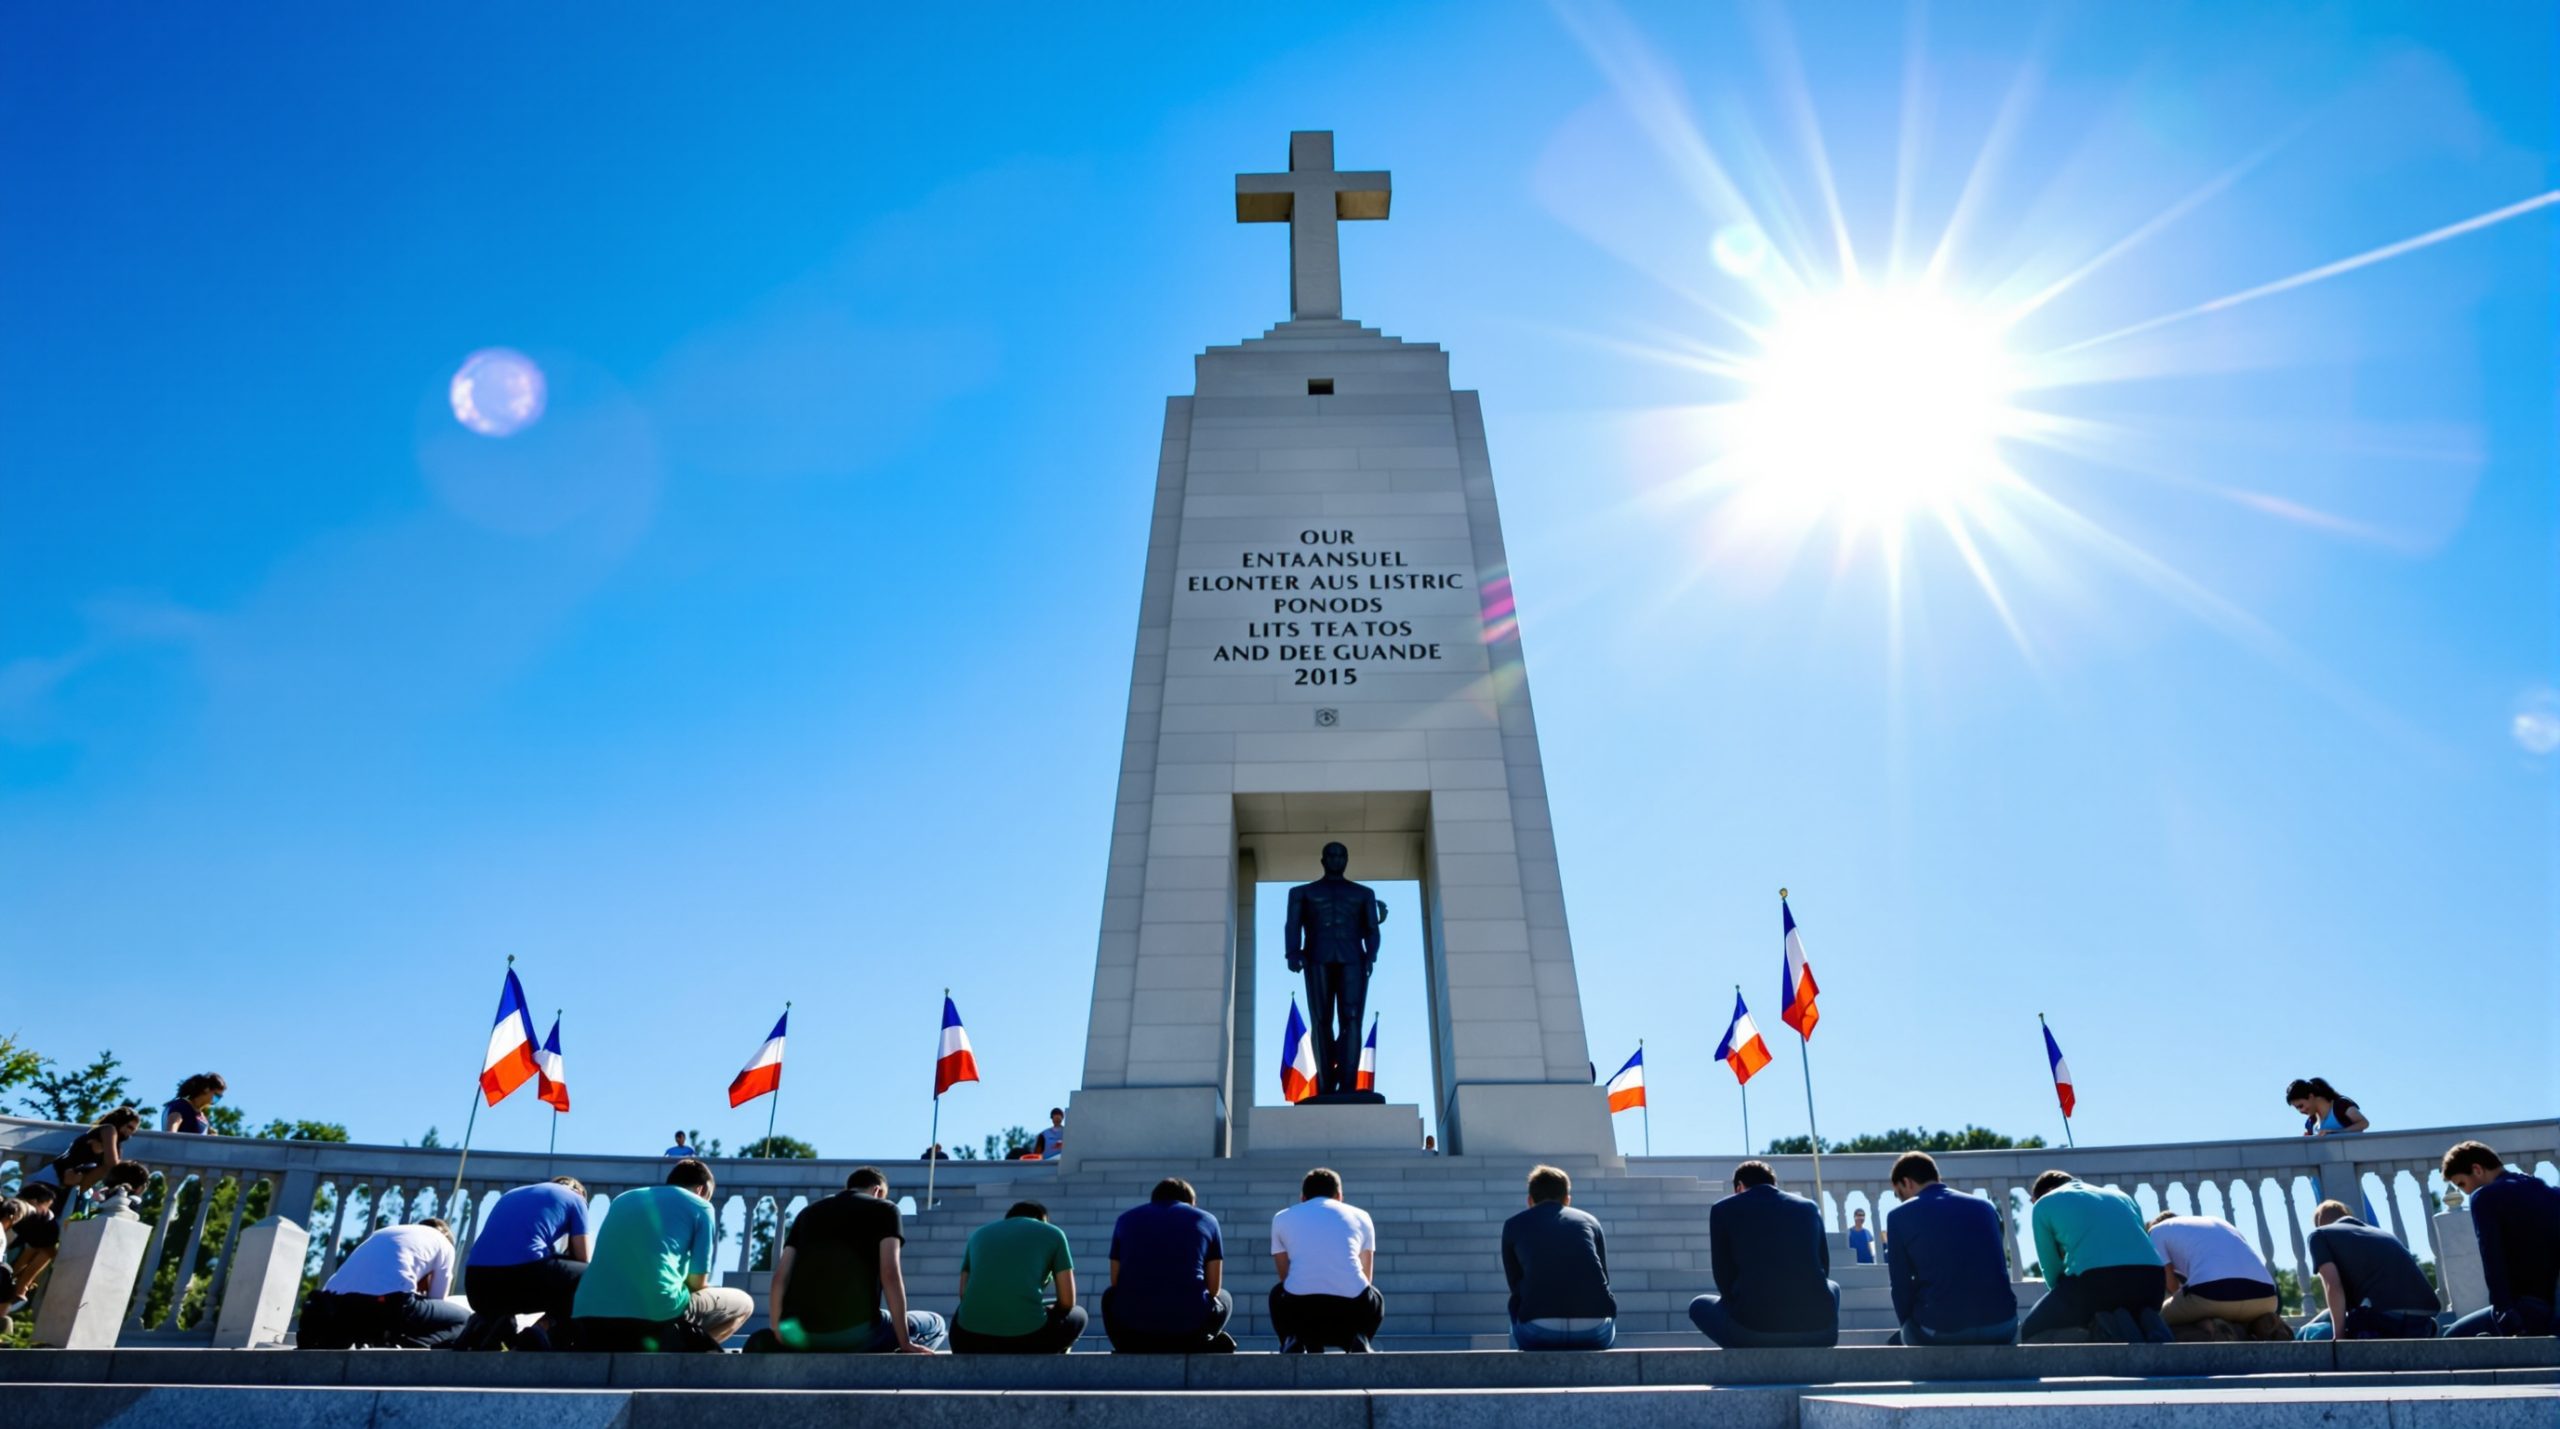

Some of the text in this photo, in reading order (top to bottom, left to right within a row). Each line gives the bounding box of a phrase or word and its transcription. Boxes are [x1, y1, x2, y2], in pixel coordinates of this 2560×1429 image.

[1300, 529, 1355, 545] OUR
[1242, 551, 1408, 568] ENTAANSUEL
[1188, 573, 1463, 592] ELONTER AUS LISTRIC
[1274, 597, 1383, 614] PONODS
[1249, 621, 1301, 638] LITS
[1213, 643, 1442, 662] AND DEE GUANDE
[1294, 667, 1358, 686] 2015
